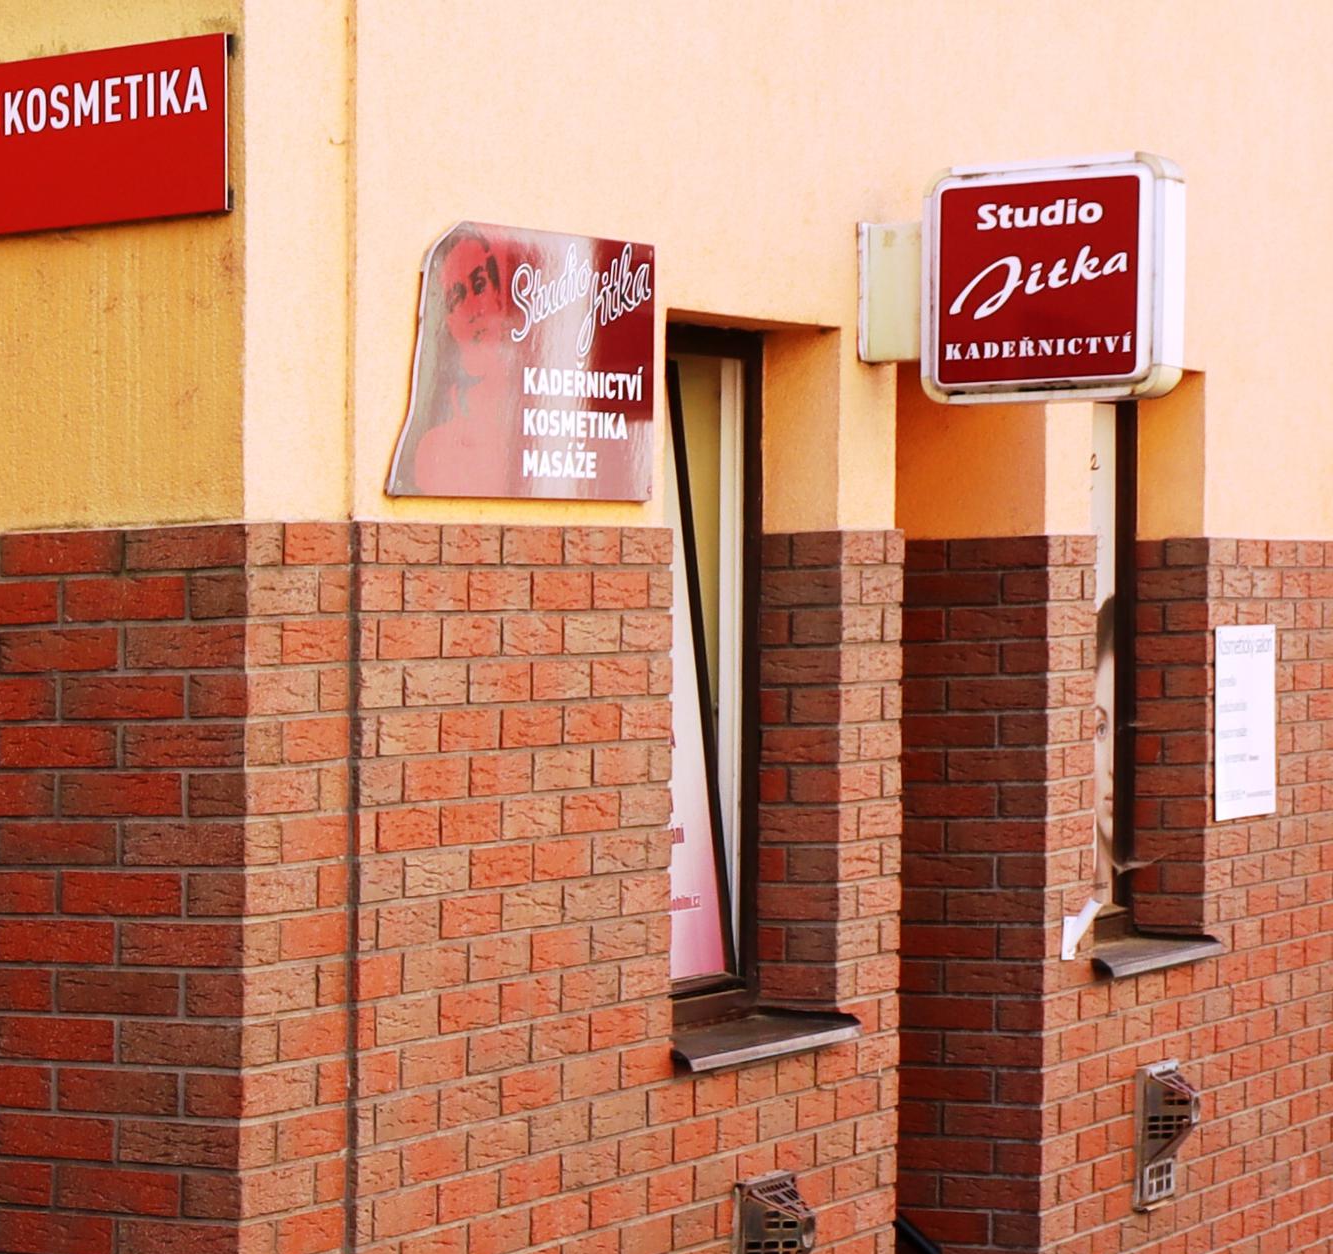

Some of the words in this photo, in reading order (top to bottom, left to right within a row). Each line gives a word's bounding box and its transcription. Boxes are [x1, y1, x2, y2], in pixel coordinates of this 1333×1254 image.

[4, 66, 208, 136] KOSMETIKA
[976, 197, 1104, 231] Studio
[511, 243, 594, 342] Studio
[576, 243, 652, 358] Jitka
[948, 244, 1129, 321] Jitka
[944, 331, 1132, 361] KADEŘNICTVÍ
[523, 362, 644, 401] KADEŘNICTVÍ
[523, 408, 629, 440] KOSMETIKA
[522, 442, 597, 478] MASÁŽE
